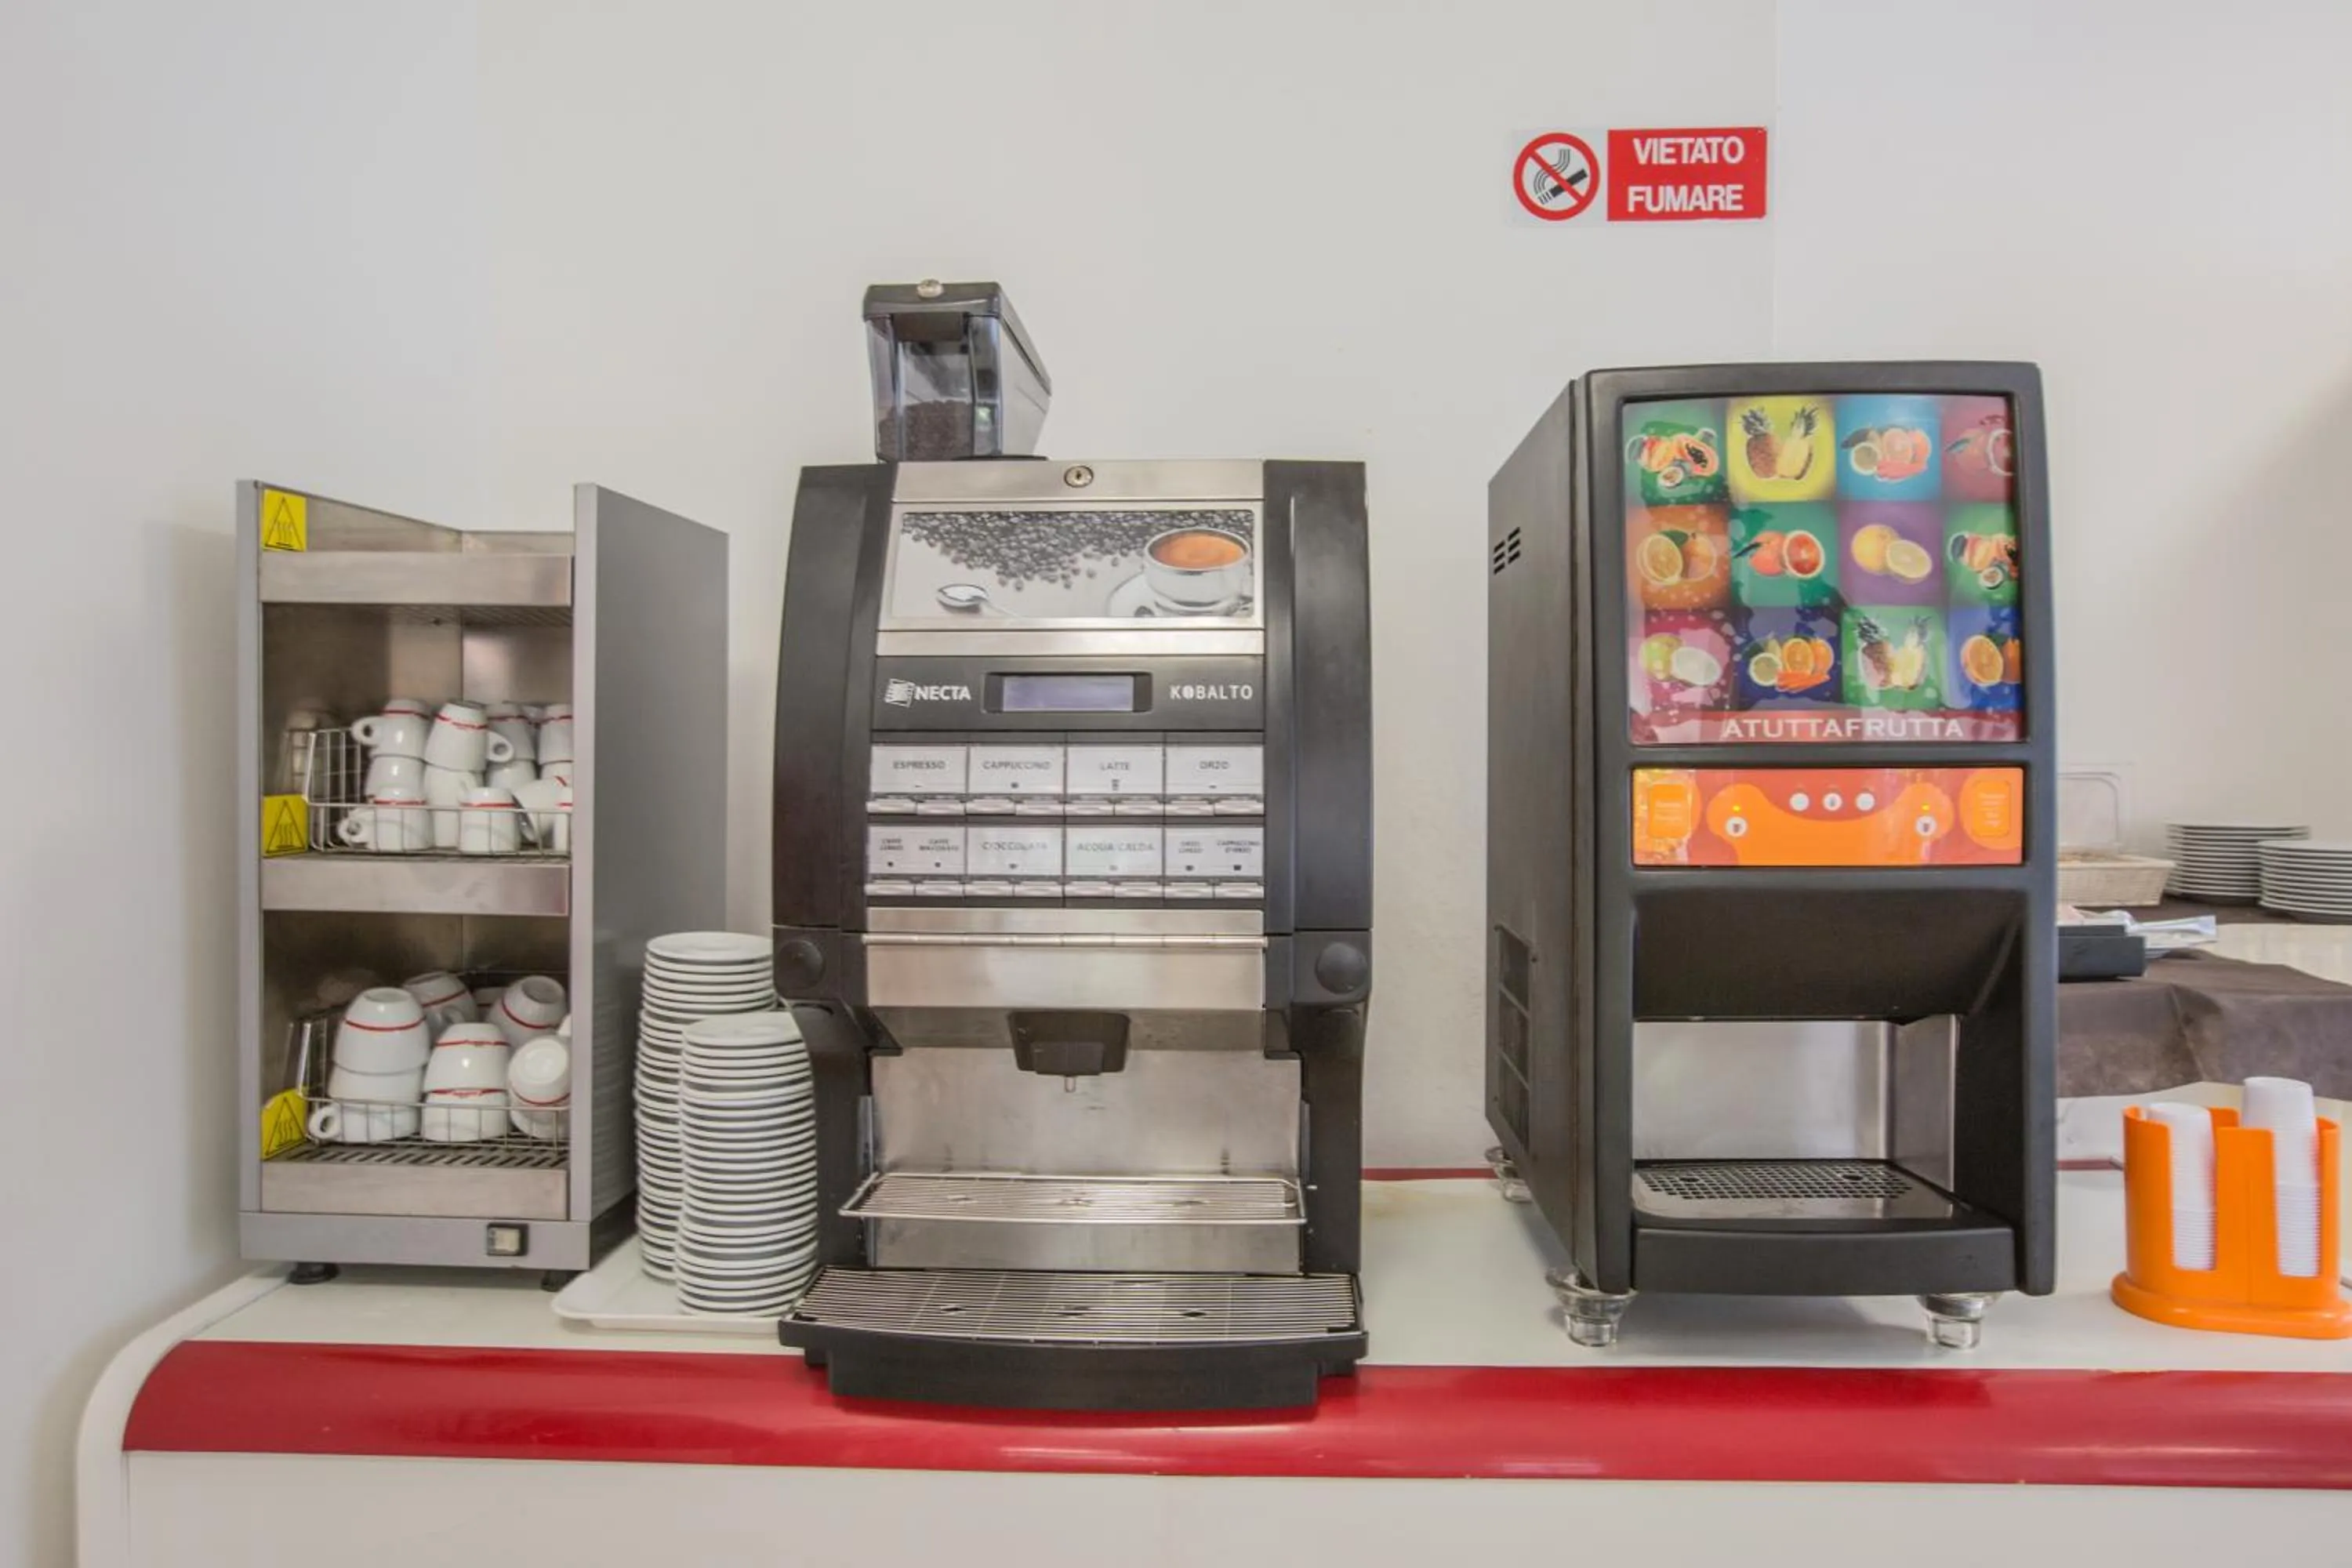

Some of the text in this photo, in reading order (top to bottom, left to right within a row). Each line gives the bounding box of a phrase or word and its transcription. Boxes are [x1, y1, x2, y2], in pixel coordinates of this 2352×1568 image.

[1632, 136, 1745, 165] VIETATO
[1627, 184, 1744, 212] FUMARE
[914, 685, 971, 700] NECTA
[1169, 684, 1254, 700] KOBALTO
[1723, 717, 1964, 739] ATUTTAFRUTTA
[892, 760, 946, 770] ESPRESSO
[982, 760, 1052, 771] CAPPUCCINO
[1100, 761, 1131, 771] LATTE
[1199, 760, 1230, 771] ORZO
